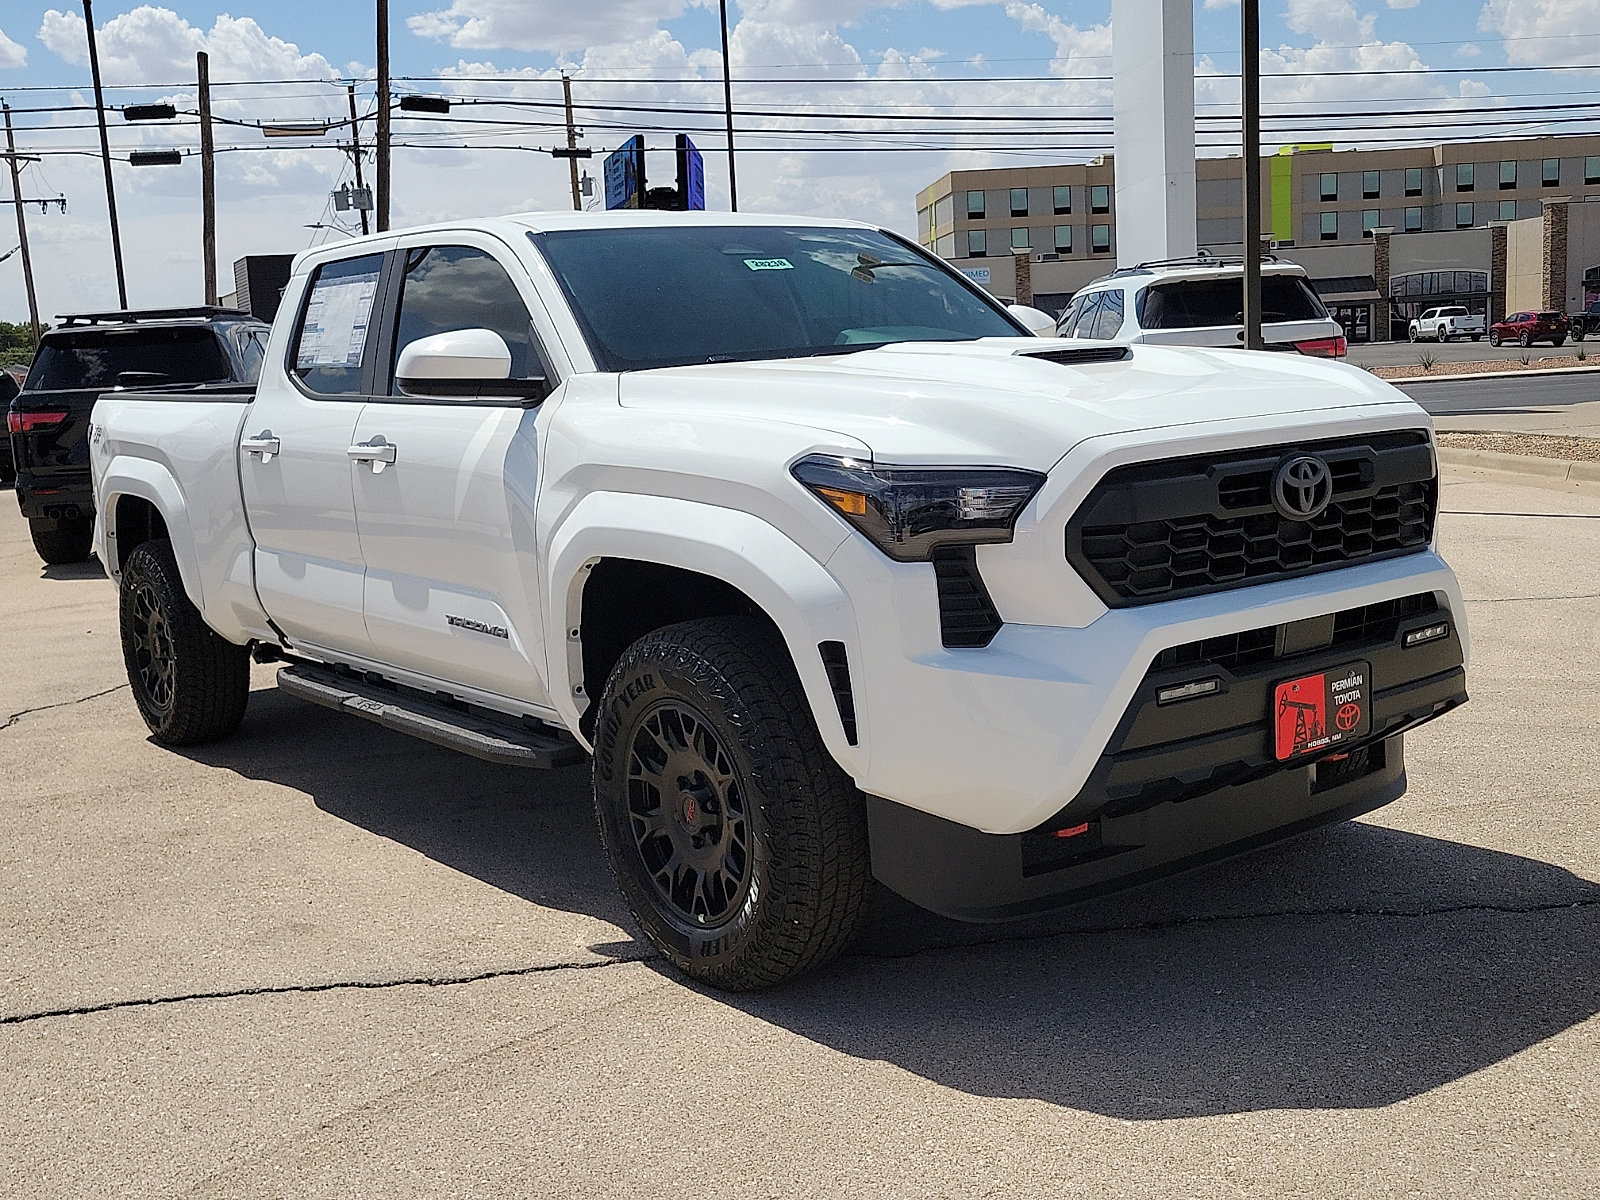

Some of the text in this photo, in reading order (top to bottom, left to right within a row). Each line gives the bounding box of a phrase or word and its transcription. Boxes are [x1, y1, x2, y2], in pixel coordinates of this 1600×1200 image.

[445, 614, 509, 640] TACOMA
[1331, 674, 1363, 693] PERMIAN
[1333, 689, 1361, 706] TOYOTA
[1331, 733, 1342, 742] NM
